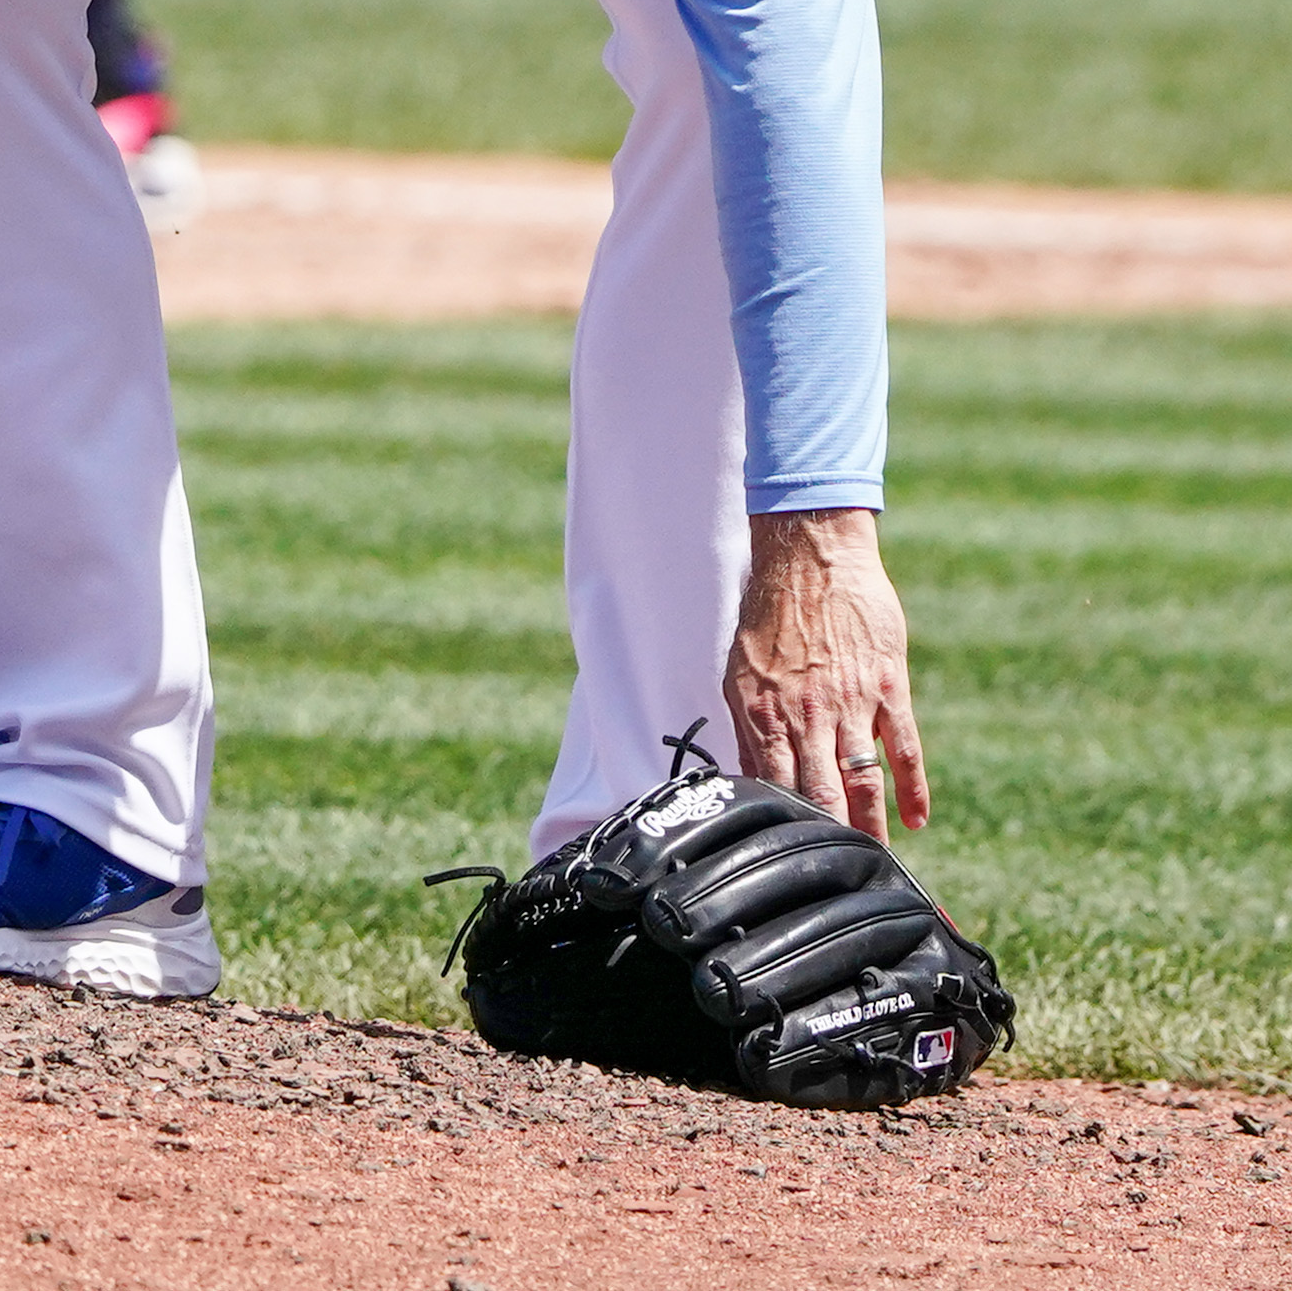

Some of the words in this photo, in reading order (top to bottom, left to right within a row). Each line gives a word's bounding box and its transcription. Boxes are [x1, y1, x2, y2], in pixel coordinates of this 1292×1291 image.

[636, 776, 736, 838] Rawlings
[806, 1015, 834, 1035] THE
[832, 1006, 863, 1029] GOLD
[863, 996, 898, 1020] GLOVE
